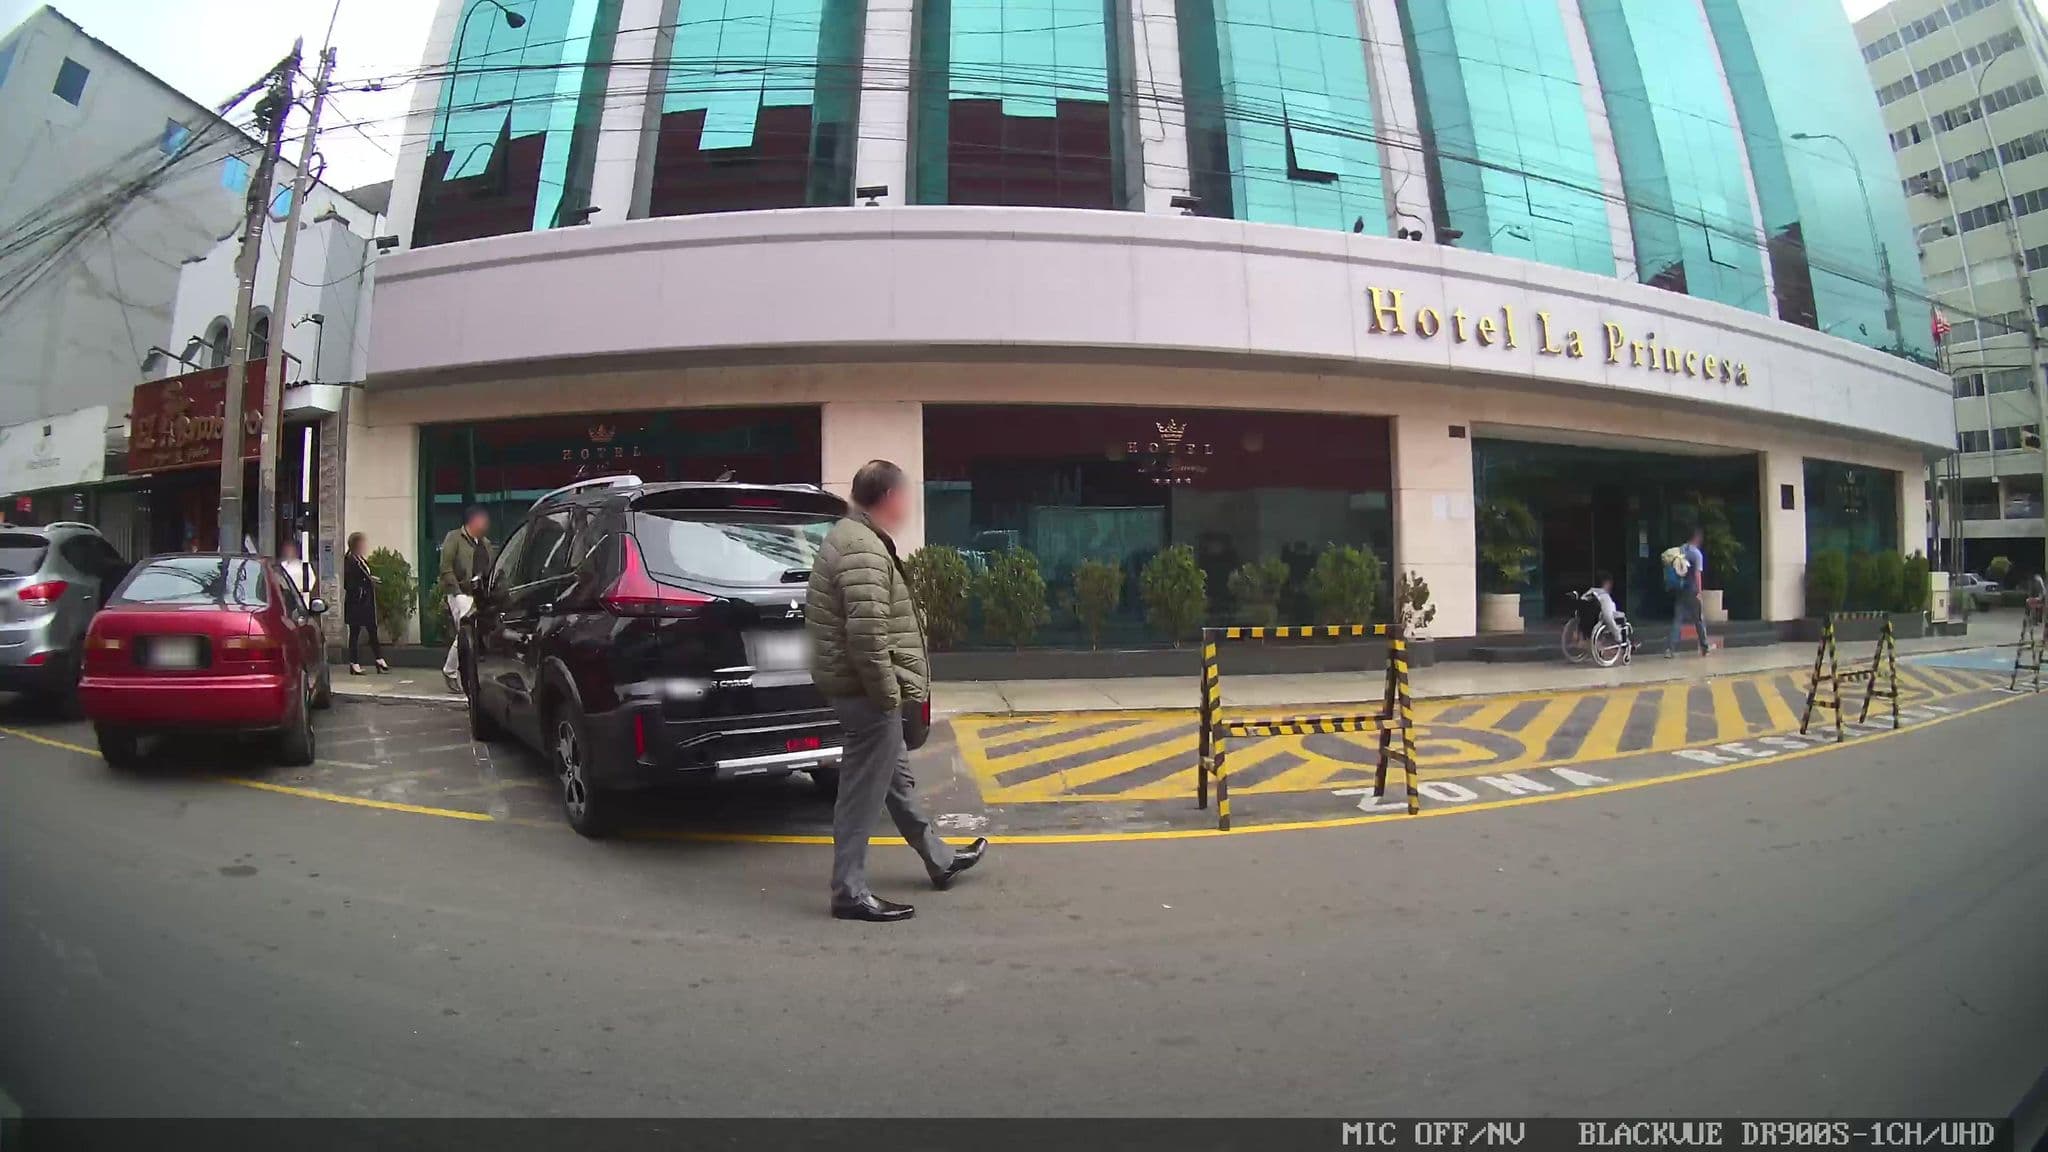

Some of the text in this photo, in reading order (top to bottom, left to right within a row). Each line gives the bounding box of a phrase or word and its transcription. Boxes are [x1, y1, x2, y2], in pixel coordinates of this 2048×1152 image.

[1367, 286, 1750, 387] Hotel La Princesa
[1331, 767, 1612, 812] ZONA
